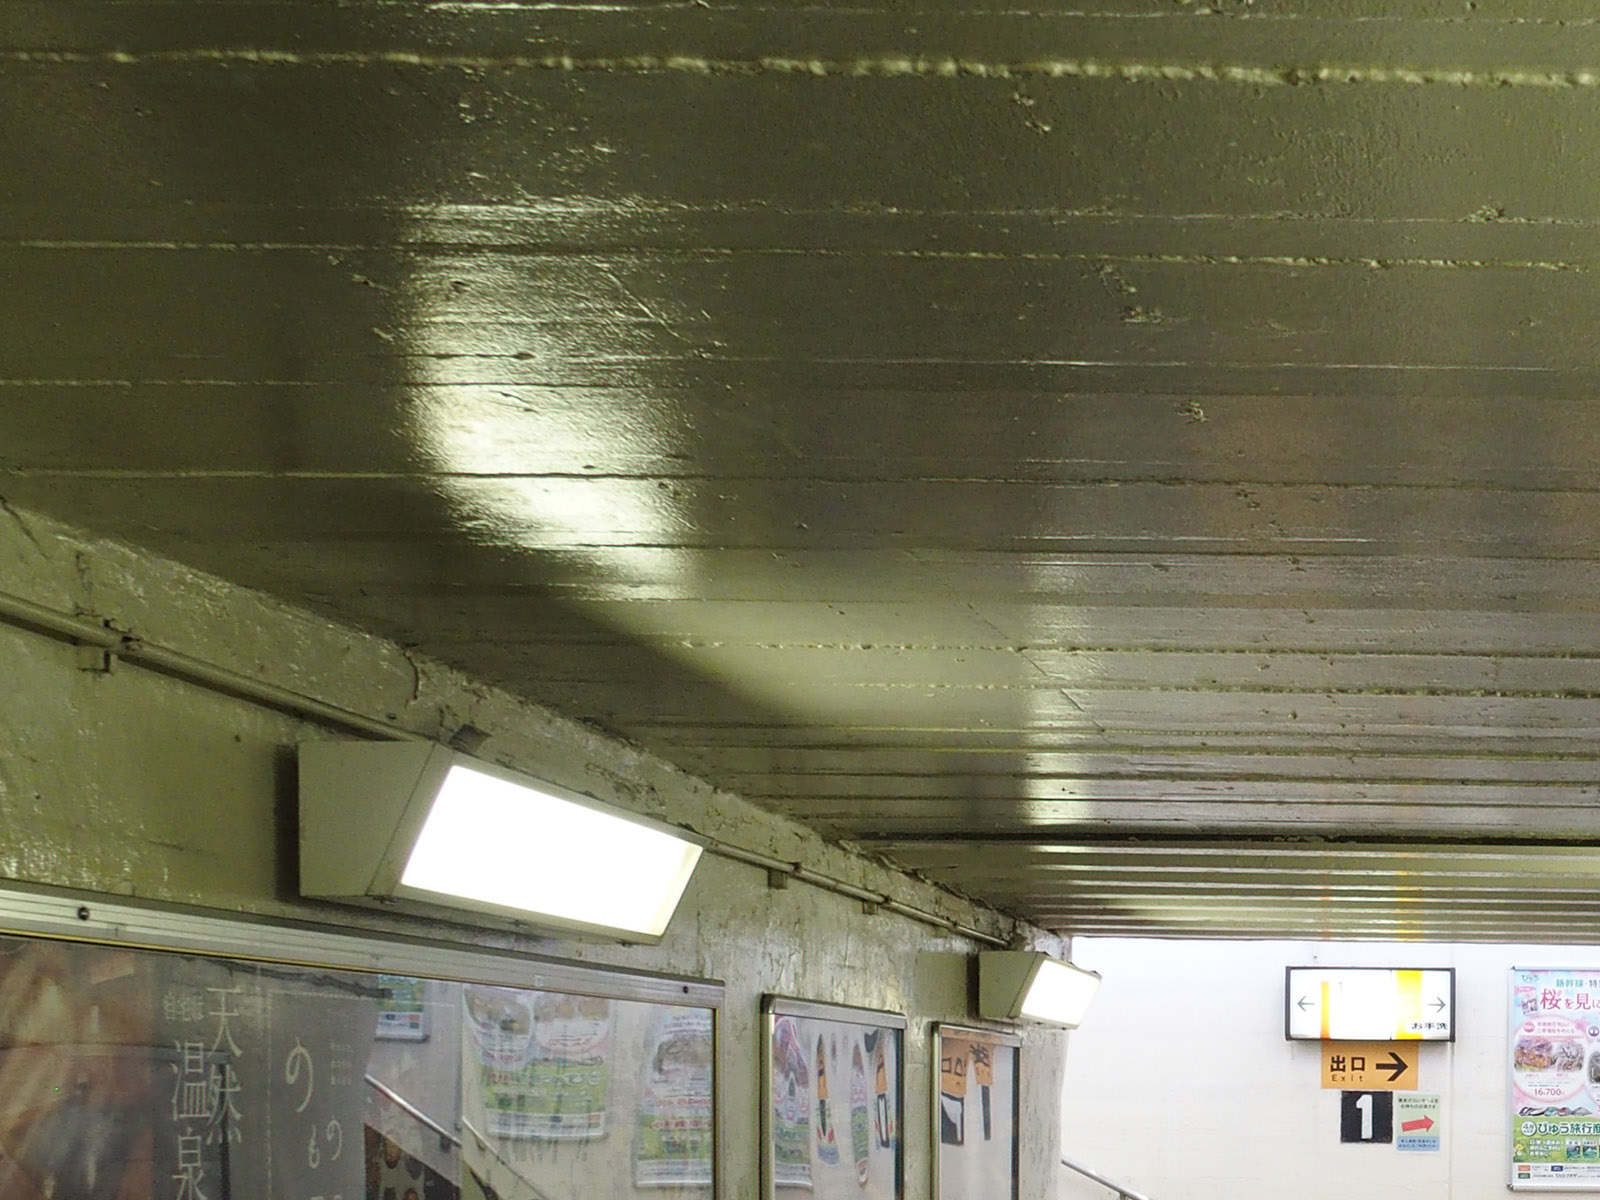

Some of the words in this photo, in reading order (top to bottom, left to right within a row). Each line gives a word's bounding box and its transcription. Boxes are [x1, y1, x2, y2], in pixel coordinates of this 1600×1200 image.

[1330, 1055, 1366, 1072] 出口
[1331, 1074, 1364, 1082] Exit
[1356, 1094, 1373, 1140] 1
